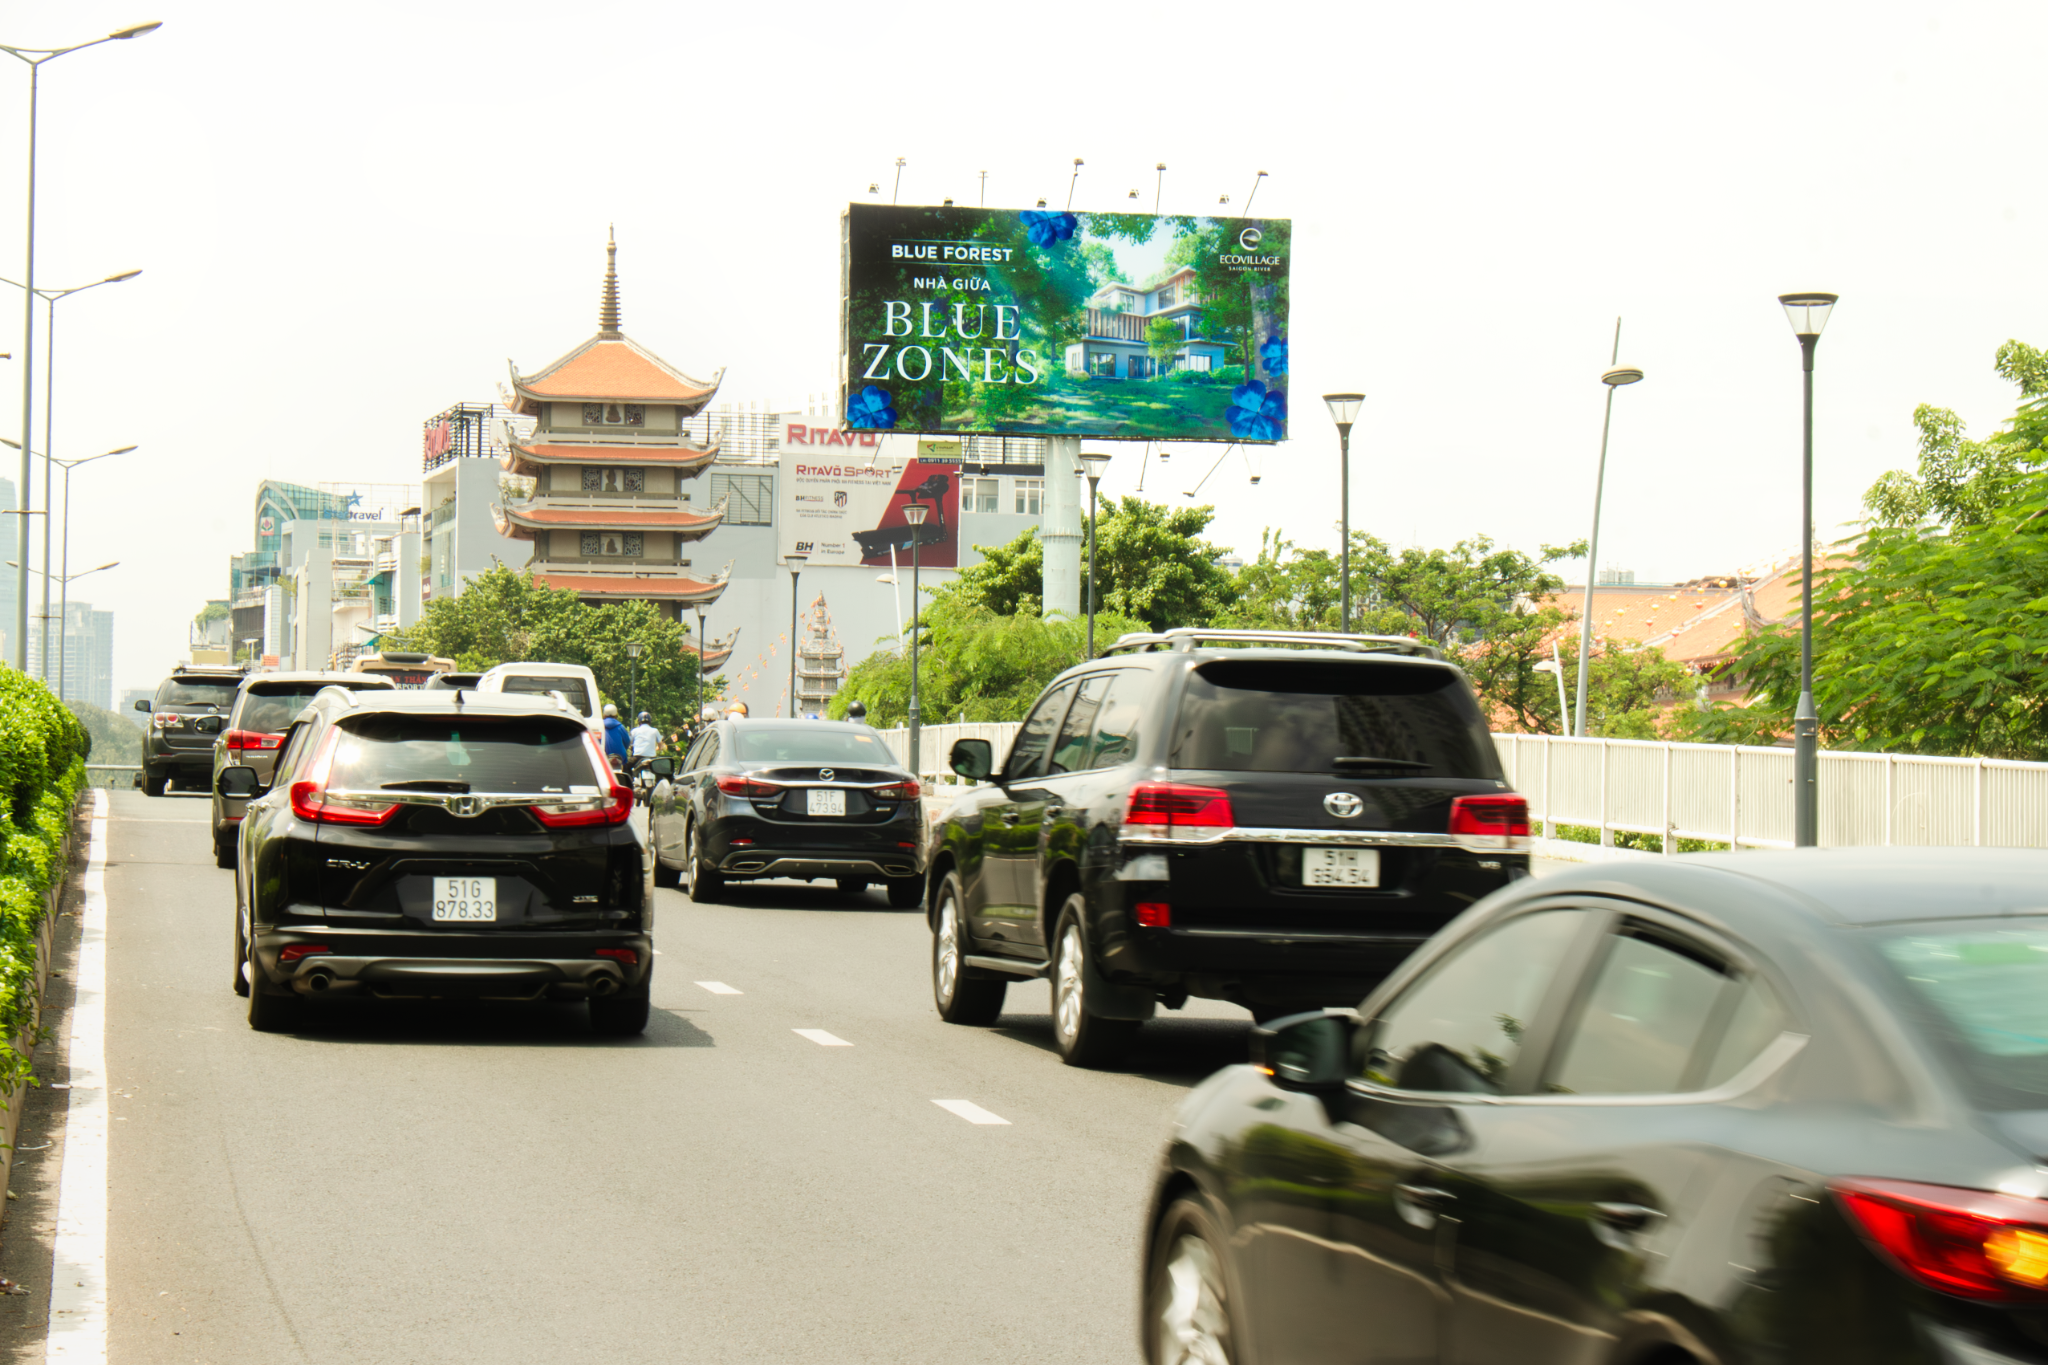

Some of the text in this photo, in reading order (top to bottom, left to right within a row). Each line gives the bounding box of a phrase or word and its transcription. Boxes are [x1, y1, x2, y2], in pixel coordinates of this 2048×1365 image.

[892, 245, 1013, 262] BLUE FOREST
[1220, 254, 1280, 265] ECOVILLAGE
[914, 275, 991, 291] NHÀ GIỮA
[883, 301, 1021, 341] BLUE
[863, 343, 1038, 385] ZONES
[796, 541, 814, 551] BH
[815, 790, 836, 802] 51F
[809, 802, 843, 814] 473.94
[326, 859, 371, 870] CR-V
[448, 879, 482, 899] 51G
[435, 900, 494, 919] 878.33
